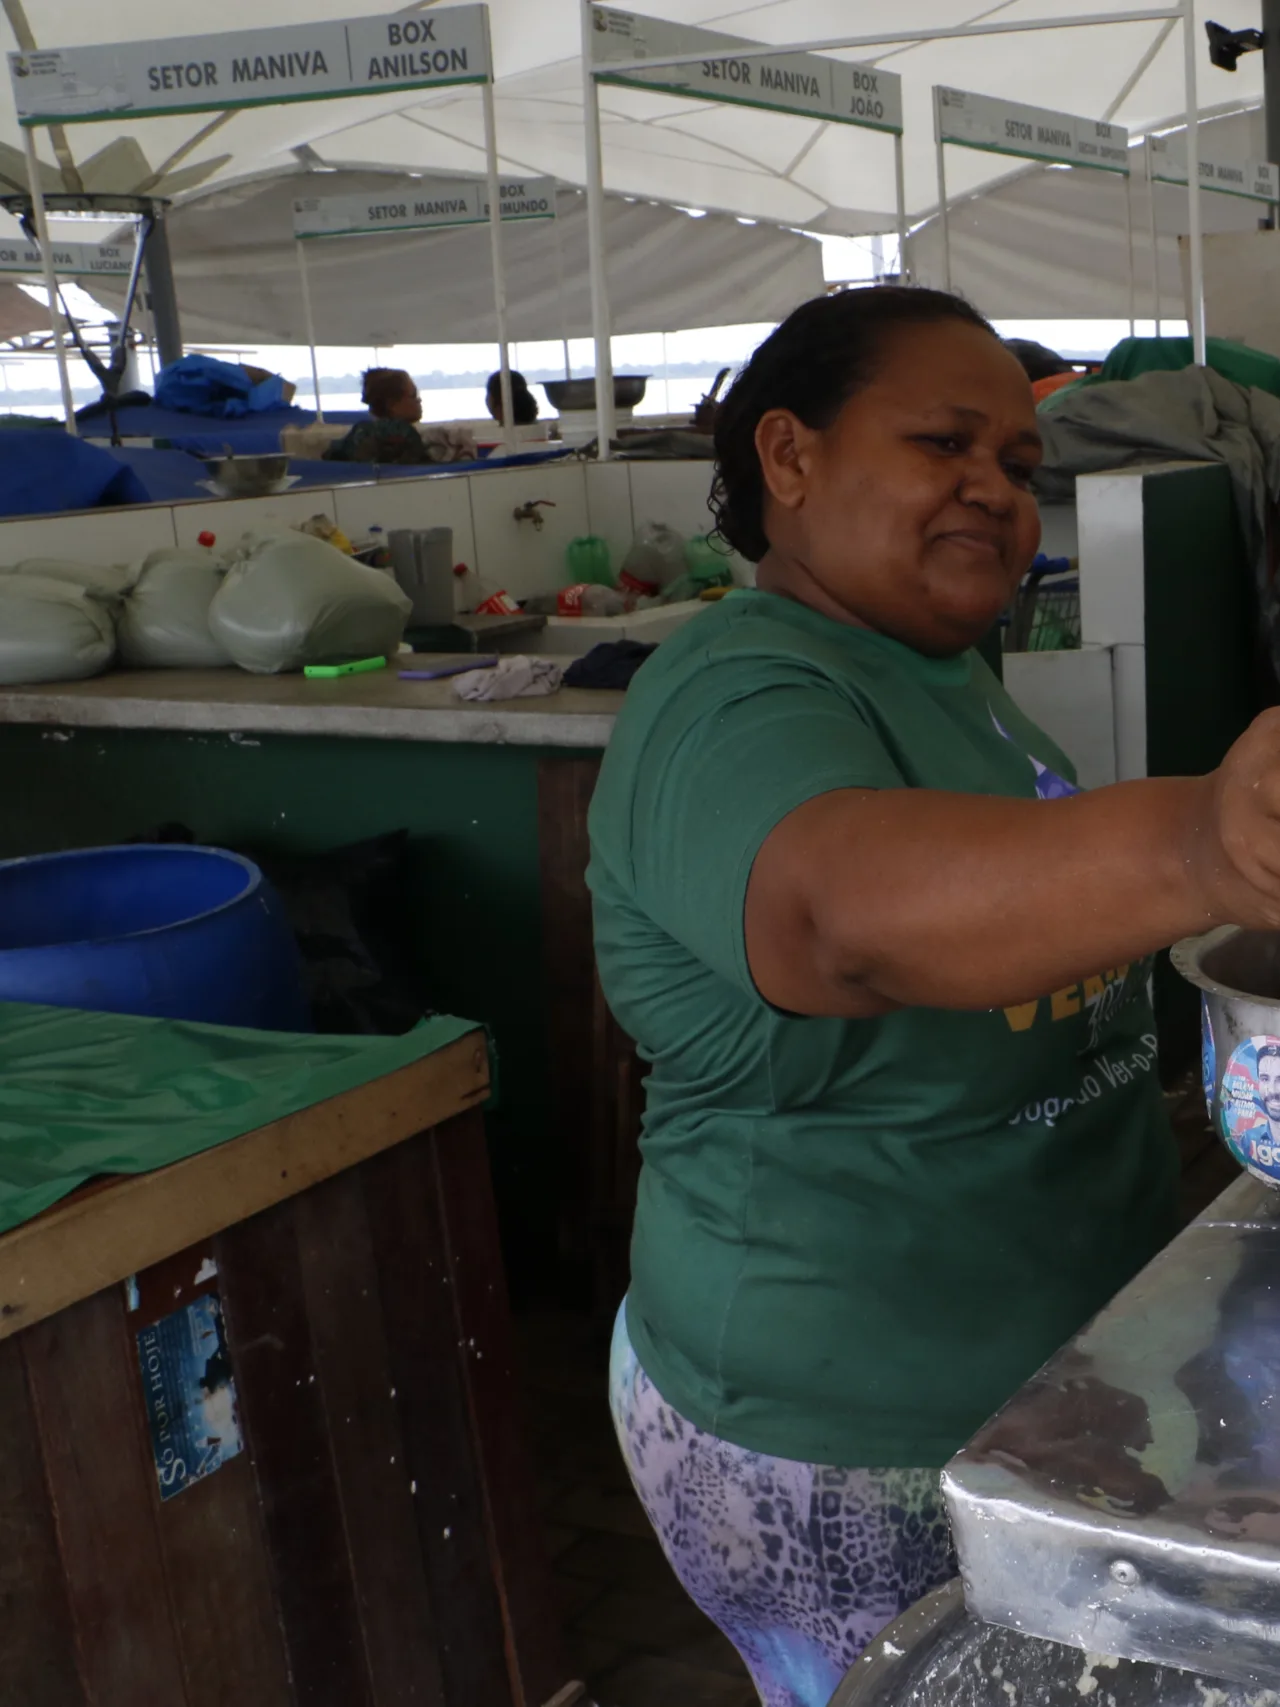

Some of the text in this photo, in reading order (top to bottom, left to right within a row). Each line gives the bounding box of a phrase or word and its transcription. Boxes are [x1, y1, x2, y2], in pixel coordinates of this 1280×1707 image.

[387, 18, 436, 46] BOX
[148, 50, 328, 92] SETOR MANIVA
[367, 48, 468, 81] ANILSON
[703, 60, 820, 98] SETOR MANIVA
[853, 71, 879, 94] BOX
[850, 94, 884, 119] JOÃO
[1005, 119, 1072, 149] SETOR MANIVA
[1095, 121, 1113, 139] BOX
[499, 184, 526, 197] BOX
[367, 199, 467, 220] SETOR MANIVA
[484, 199, 549, 216] RIMUNDO
[99, 247, 120, 258] BOX
[145, 1331, 163, 1391] HOJE
[153, 1394, 172, 1444] POR
